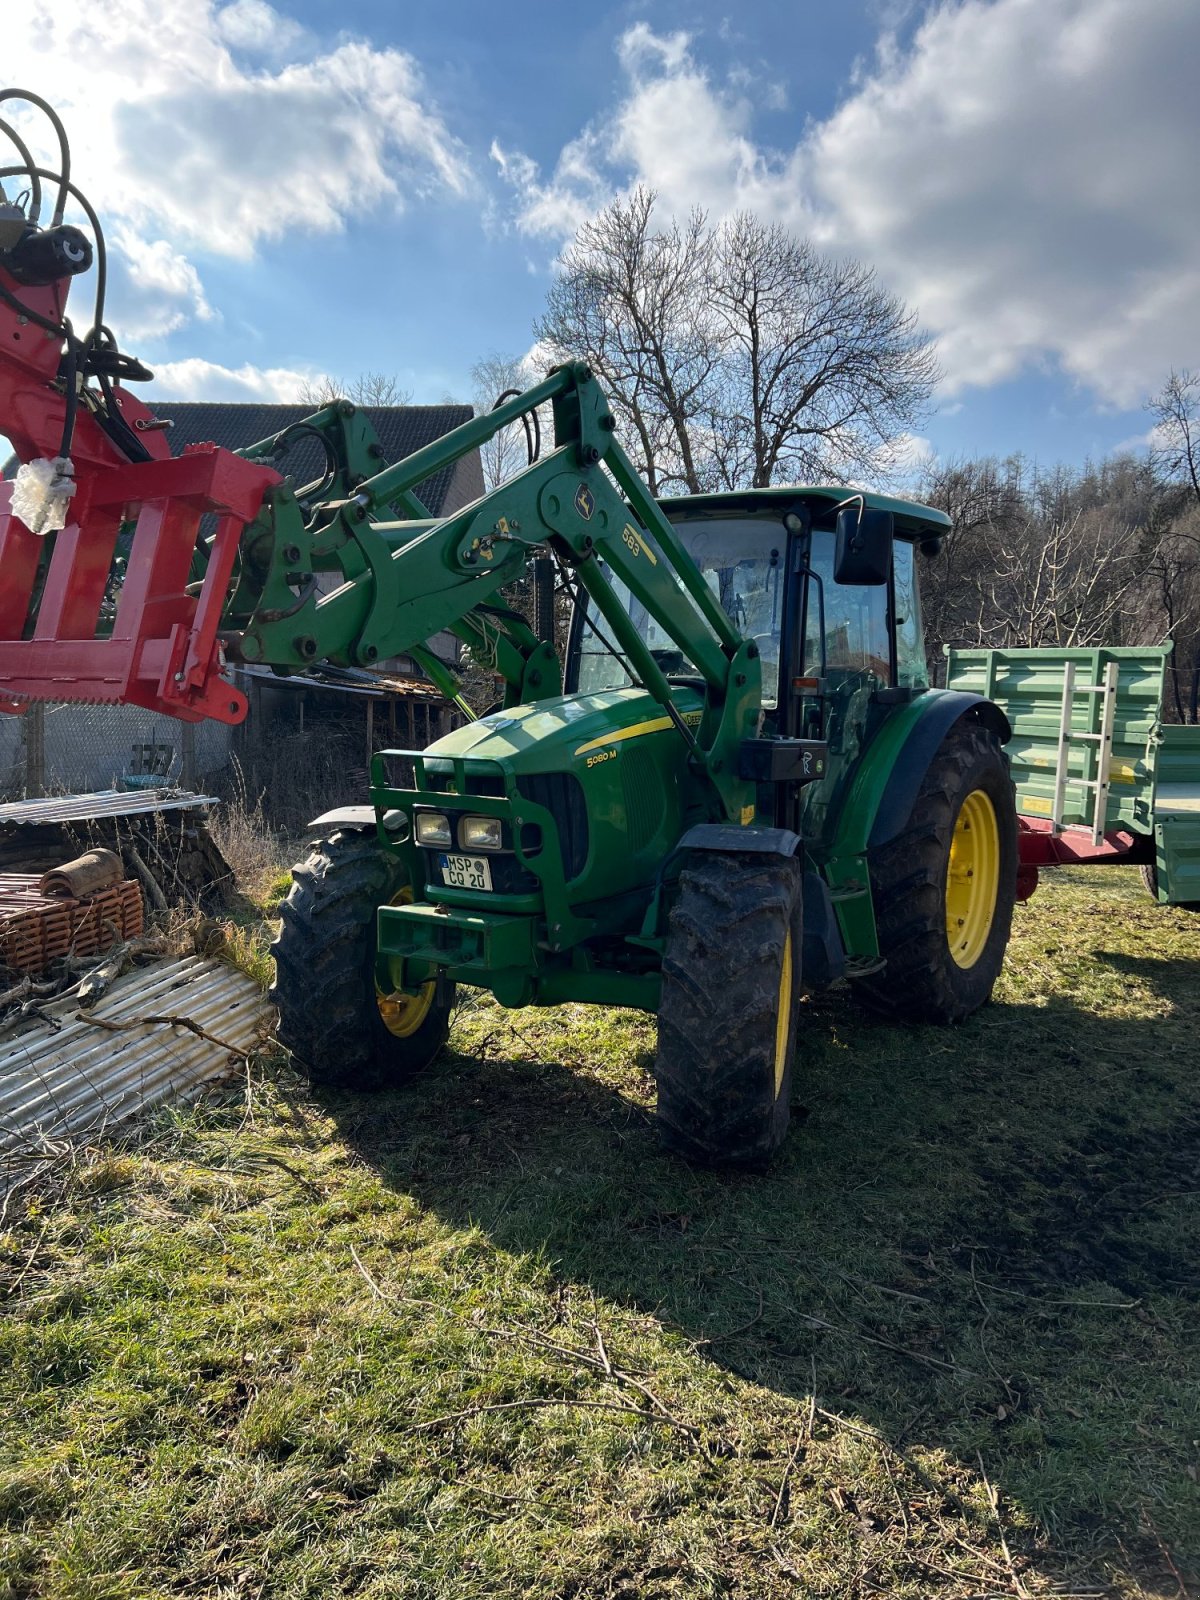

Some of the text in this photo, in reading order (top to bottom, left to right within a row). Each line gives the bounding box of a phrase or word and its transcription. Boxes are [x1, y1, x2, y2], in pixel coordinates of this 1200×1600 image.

[622, 527, 640, 557] 583
[586, 749, 617, 768] 5080 M
[448, 856, 472, 871] MSP
[469, 873, 486, 889] 20
